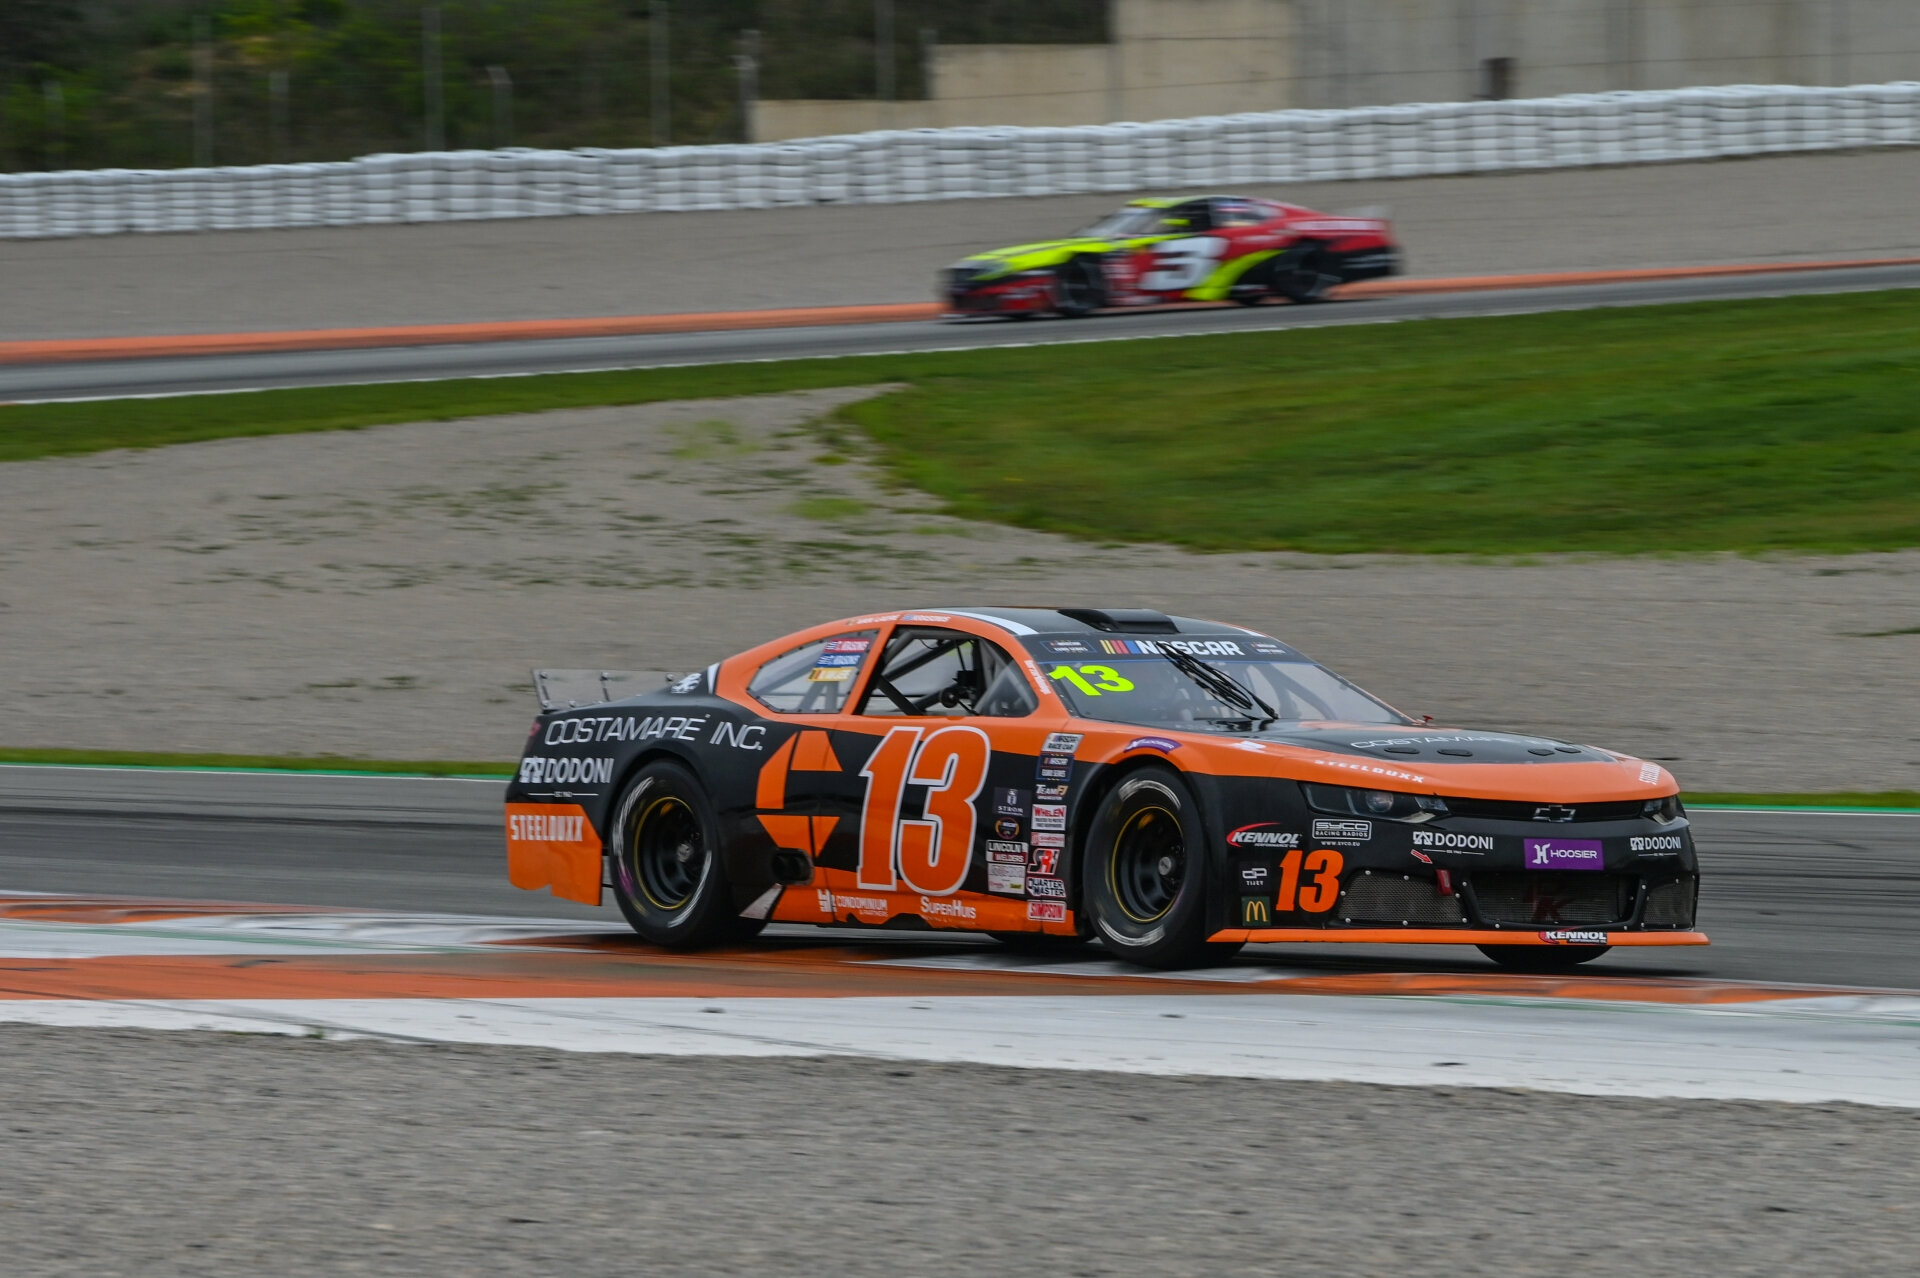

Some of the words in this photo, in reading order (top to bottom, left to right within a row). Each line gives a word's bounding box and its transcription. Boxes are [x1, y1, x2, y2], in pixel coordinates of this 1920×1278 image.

[1050, 665, 1135, 696] 13
[544, 717, 706, 746] COSTAMARE
[709, 721, 767, 750] INC.
[543, 757, 615, 785] DODONI
[857, 725, 991, 897] 13
[1315, 822, 1369, 831] SYCO
[1231, 832, 1300, 844] KENNOL
[1434, 833, 1494, 850] DODONI
[1644, 836, 1682, 850] DODONI
[988, 843, 1022, 853] LINCOLN
[1550, 850, 1597, 859] HOOSIER
[1275, 849, 1344, 913] 13
[1546, 931, 1606, 940] KENNOL
